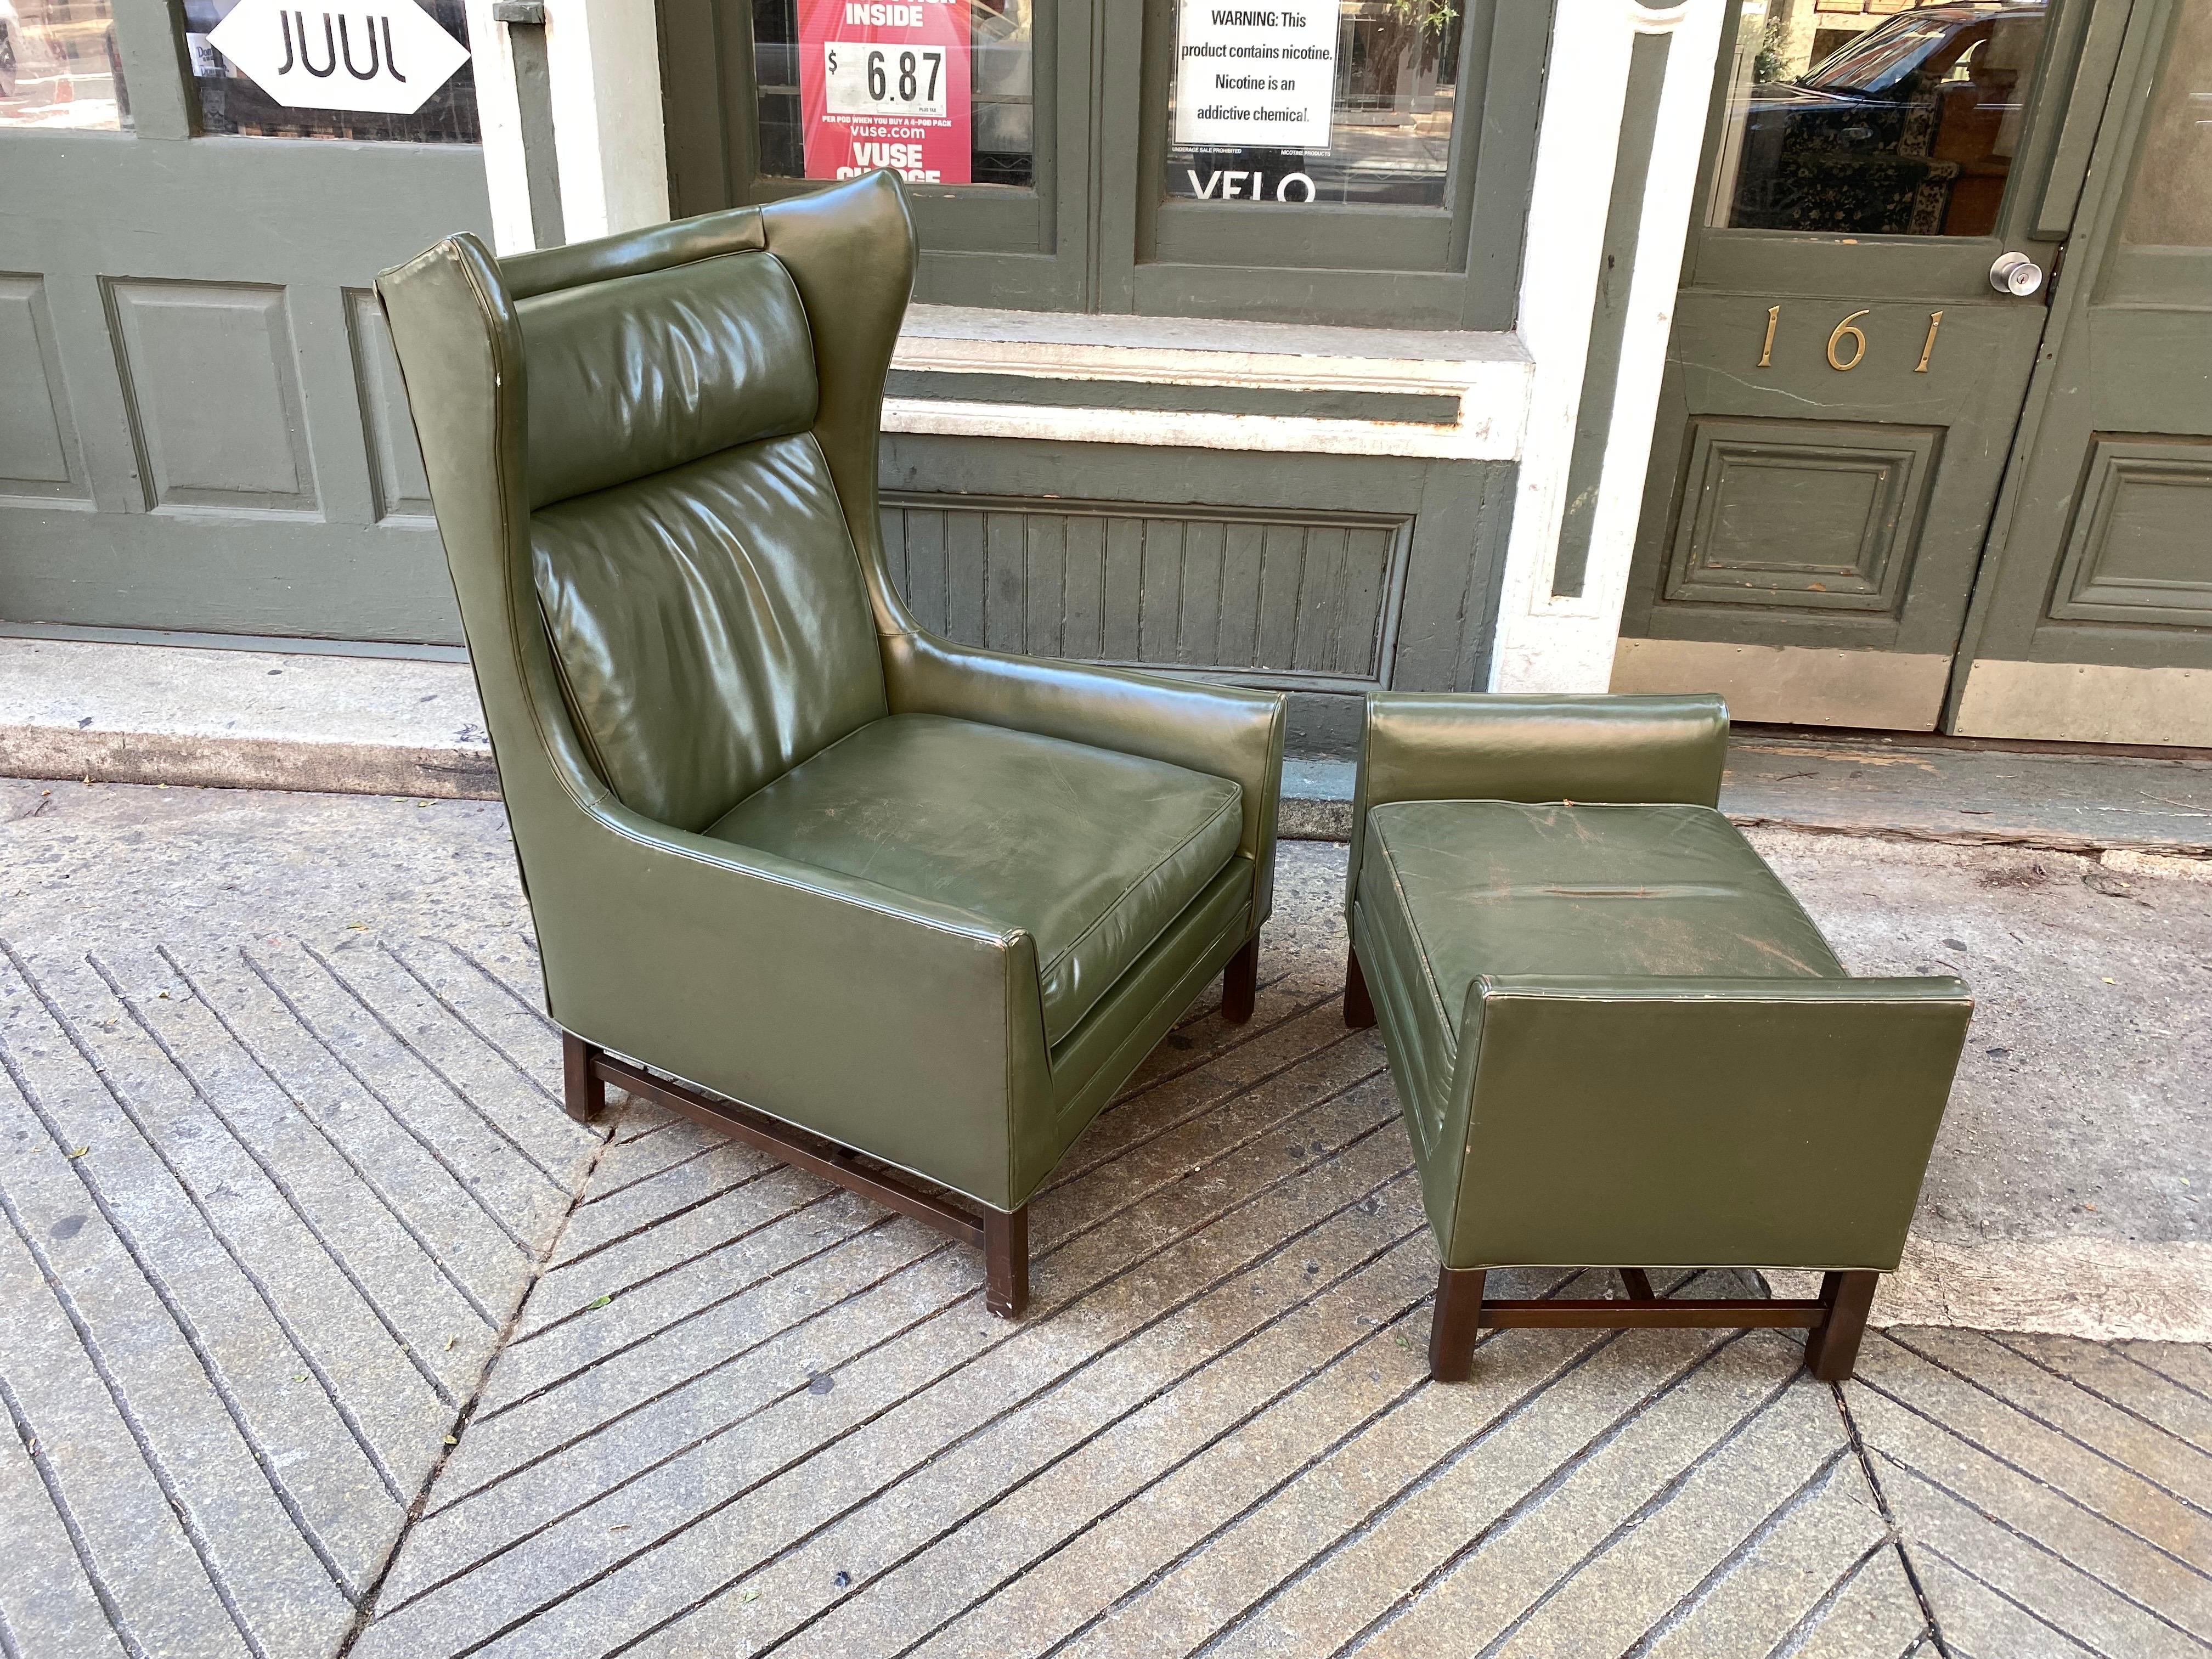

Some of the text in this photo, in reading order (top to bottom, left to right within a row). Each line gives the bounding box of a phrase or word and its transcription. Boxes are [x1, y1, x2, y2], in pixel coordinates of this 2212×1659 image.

[846, 3, 923, 27] INSIDE
[1211, 10, 1306, 27] WARNING: This
[278, 10, 406, 83] JUUL
[1181, 42, 1333, 61] product contains nicotine.
[828, 49, 941, 101] $ 6.87
[1215, 74, 1295, 91] Nicotine is an
[1197, 105, 1310, 122] addictive chemical.
[910, 119, 932, 127] 4-POD
[933, 119, 952, 127] PACK
[850, 126, 926, 139] vuse.com
[853, 142, 923, 168] VUSE
